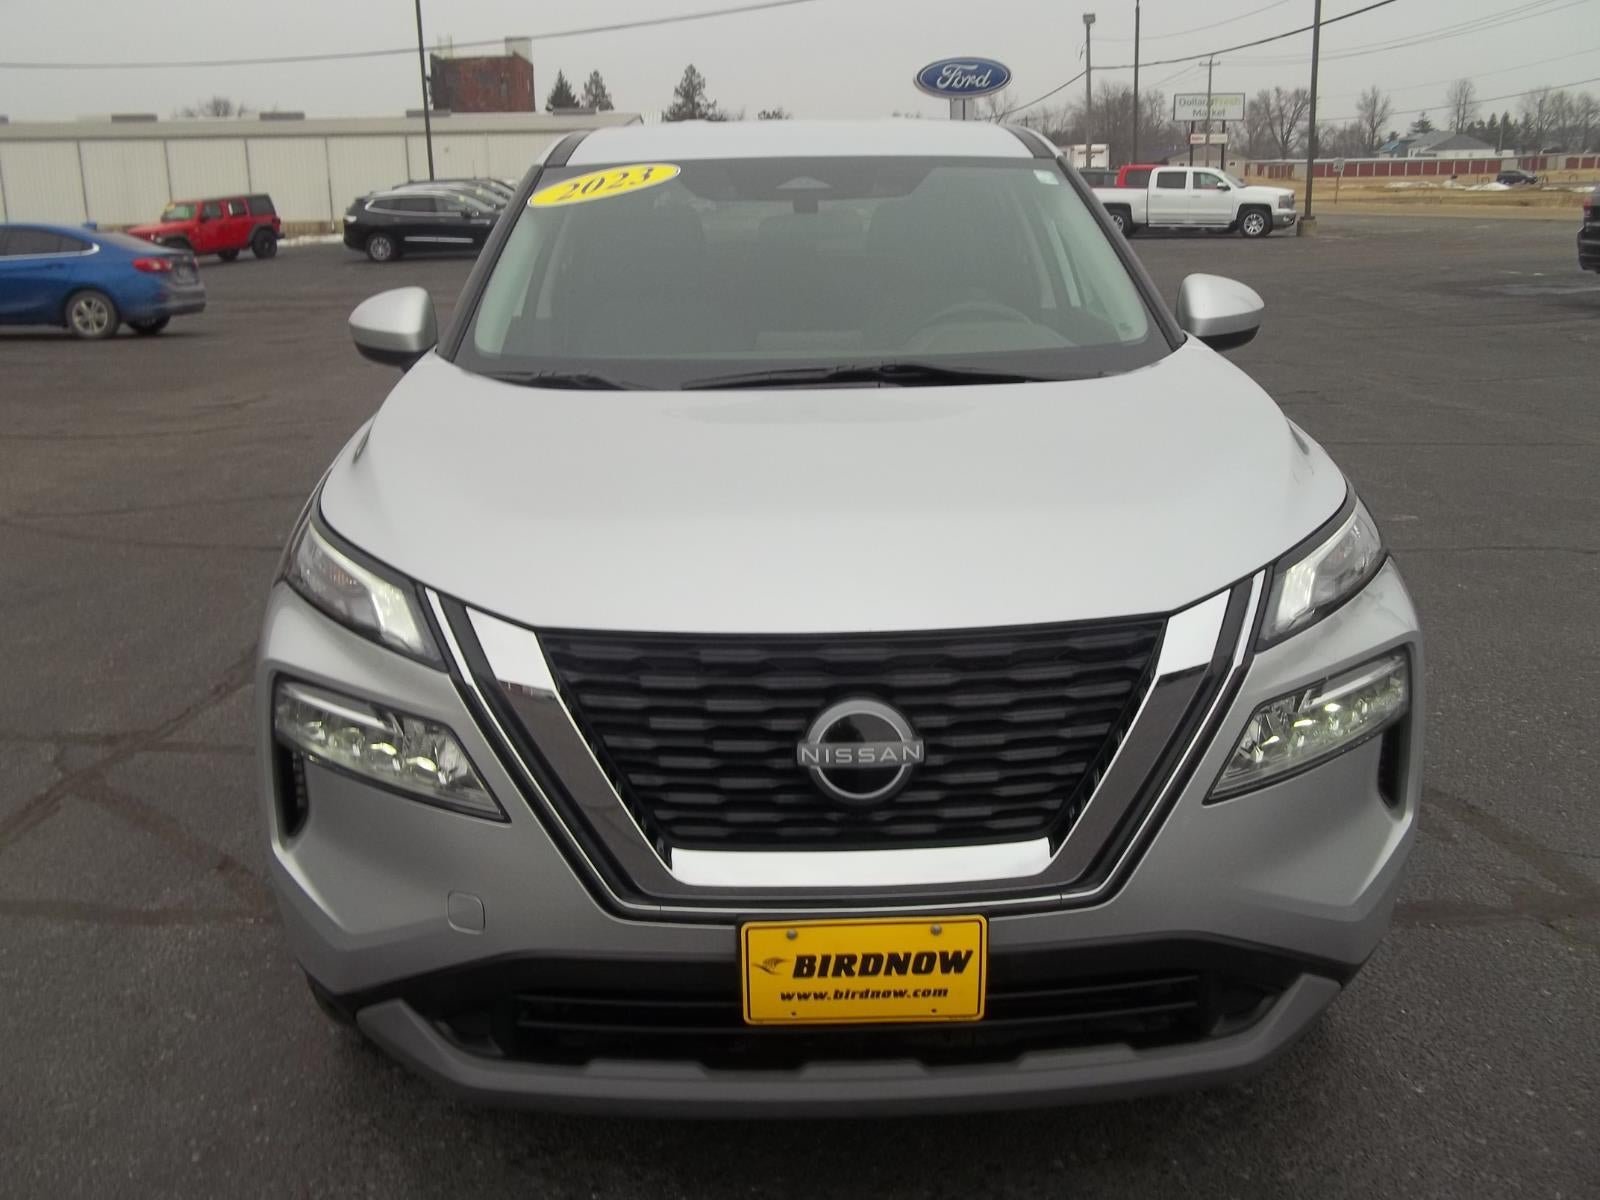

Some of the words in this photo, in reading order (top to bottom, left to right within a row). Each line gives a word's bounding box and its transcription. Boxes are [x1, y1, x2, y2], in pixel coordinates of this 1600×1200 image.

[936, 63, 992, 89] Ford
[1192, 108, 1226, 118] Maket
[557, 167, 655, 203] 2023
[800, 744, 921, 764] NISSAN
[792, 949, 974, 979] BIRDNOW
[780, 987, 948, 1001] www.birdnow.com
